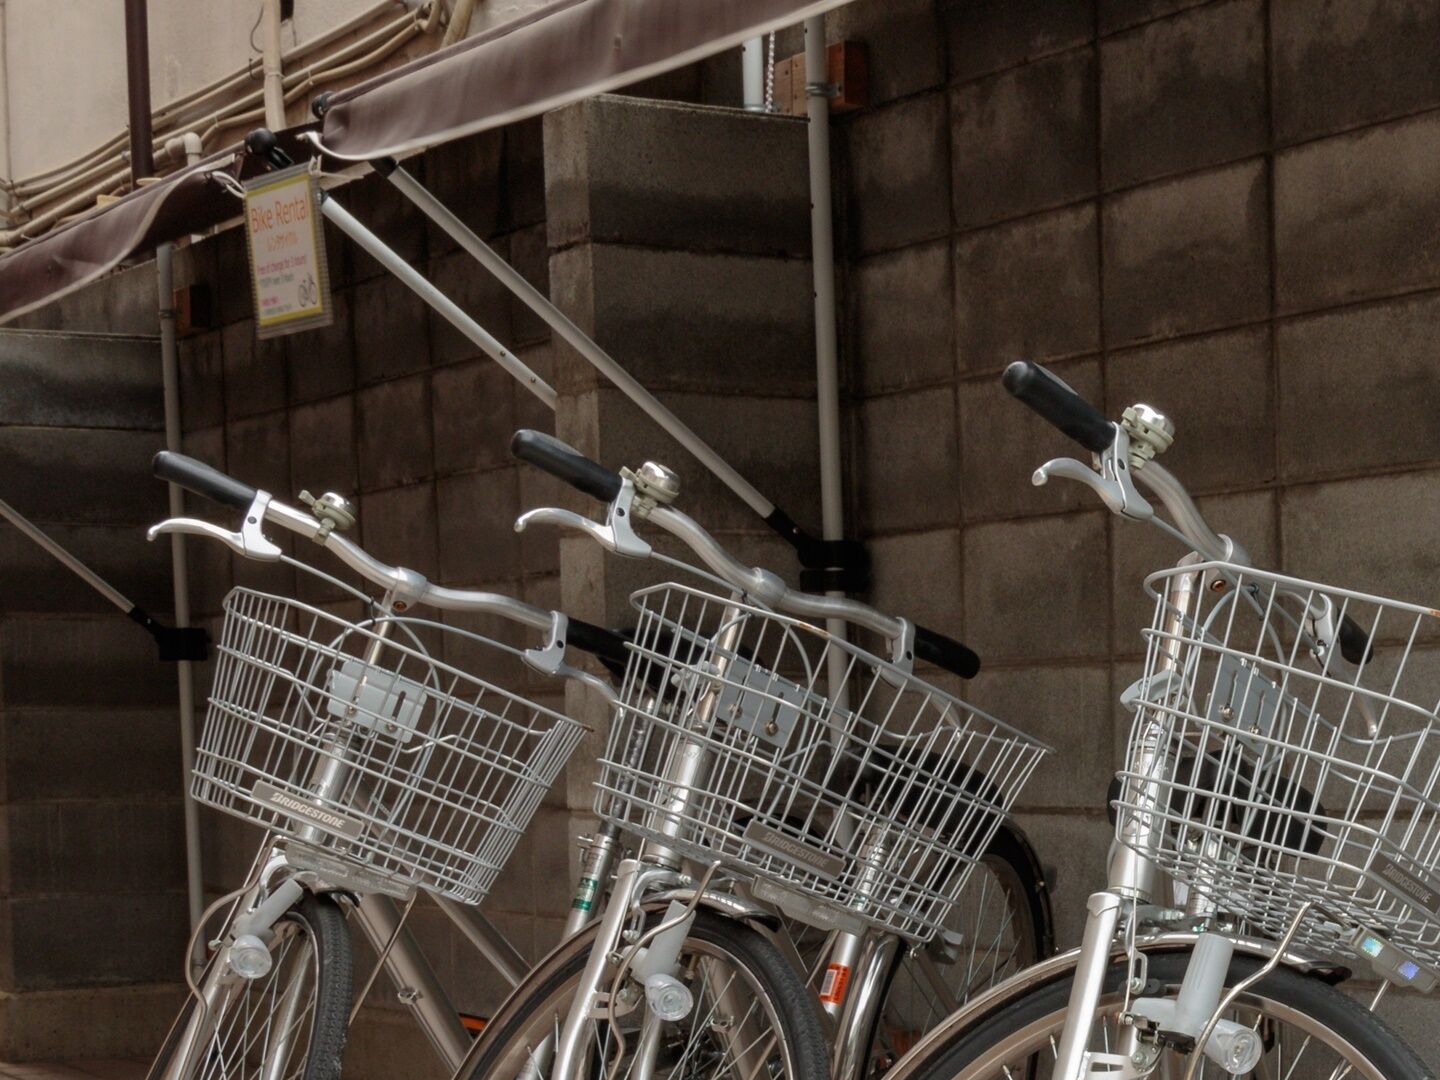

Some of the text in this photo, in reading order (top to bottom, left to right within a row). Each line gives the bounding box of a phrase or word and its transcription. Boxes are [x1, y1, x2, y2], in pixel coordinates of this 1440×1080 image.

[251, 191, 309, 232] Bike Rental
[270, 792, 346, 828] BRIDGESTONE
[763, 831, 828, 867] BRIDGESTONE
[1382, 863, 1433, 903] BRIDGESTONE
